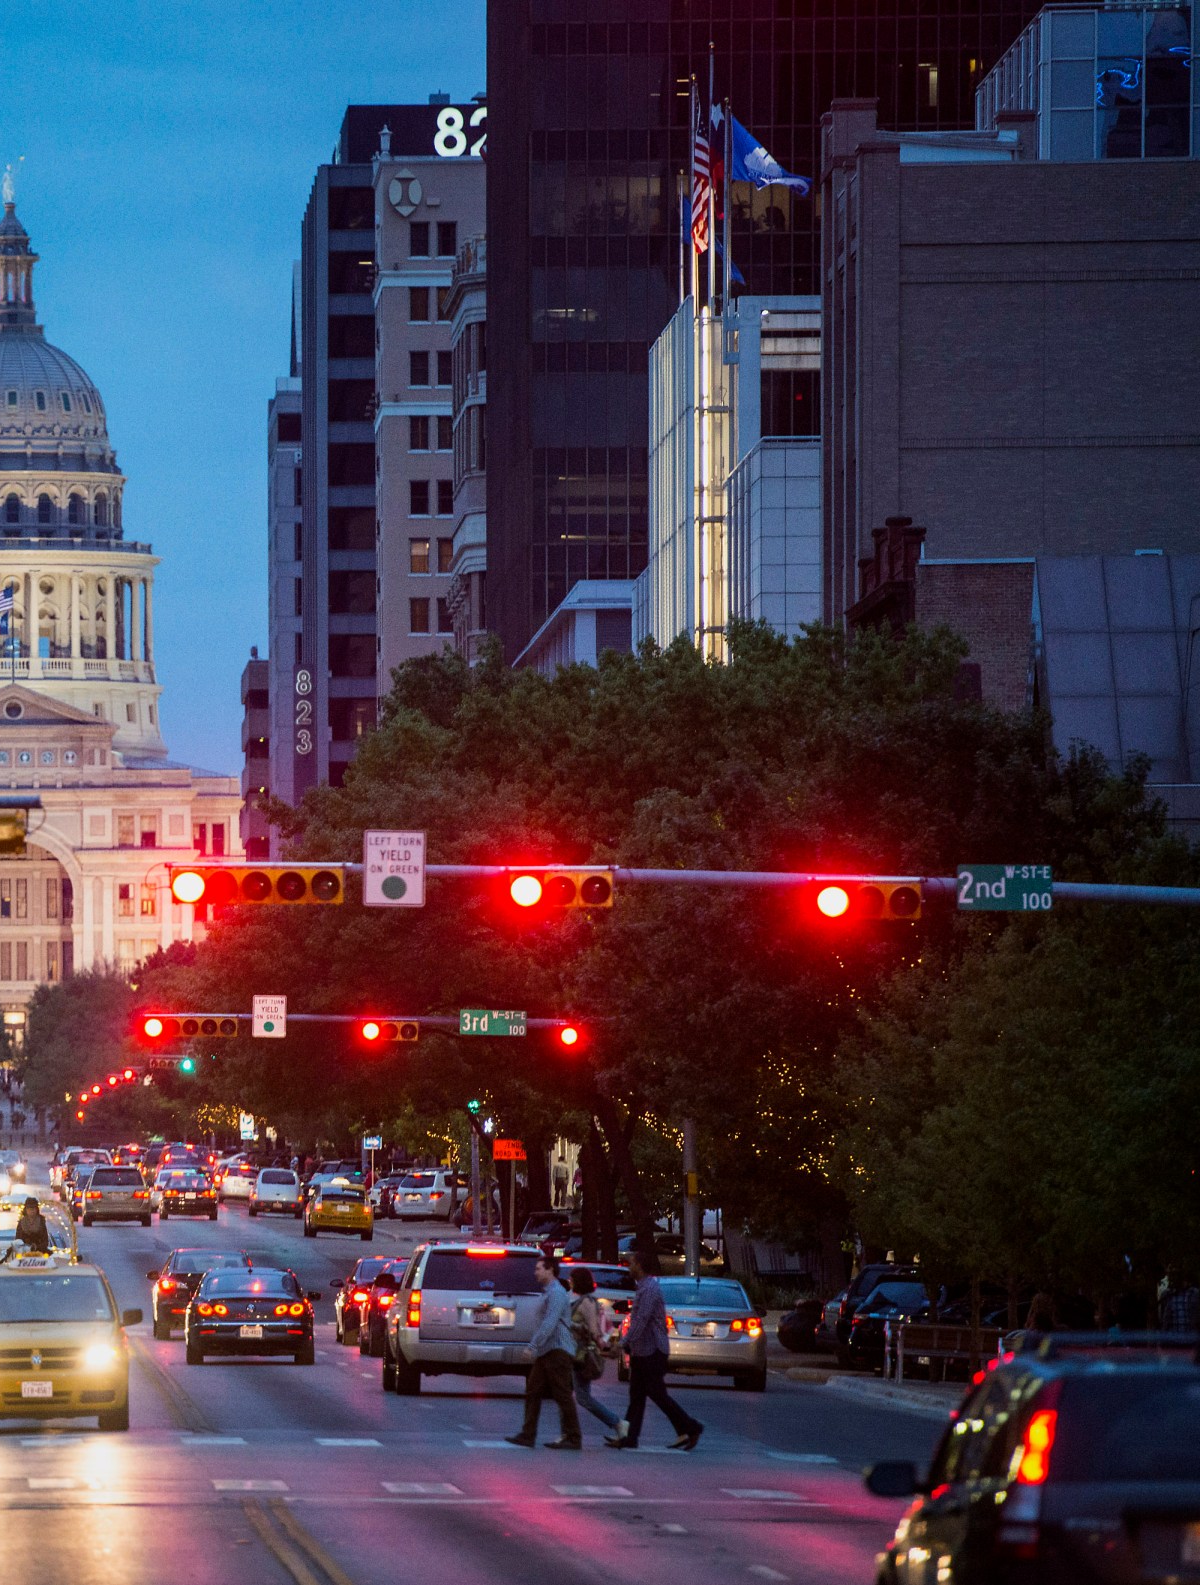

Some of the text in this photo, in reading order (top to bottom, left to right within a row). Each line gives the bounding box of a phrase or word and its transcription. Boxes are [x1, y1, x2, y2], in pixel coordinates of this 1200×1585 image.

[296, 669, 312, 755] 823
[369, 837, 422, 846] LEFT TURN
[380, 850, 411, 861] YIELD
[370, 865, 420, 874] ON GREEN
[958, 866, 1051, 904] 2nd W-ST-E
[1022, 893, 1052, 910] 100
[462, 1010, 526, 1032] 3rd W-ST-E
[509, 1025, 525, 1036] 100
